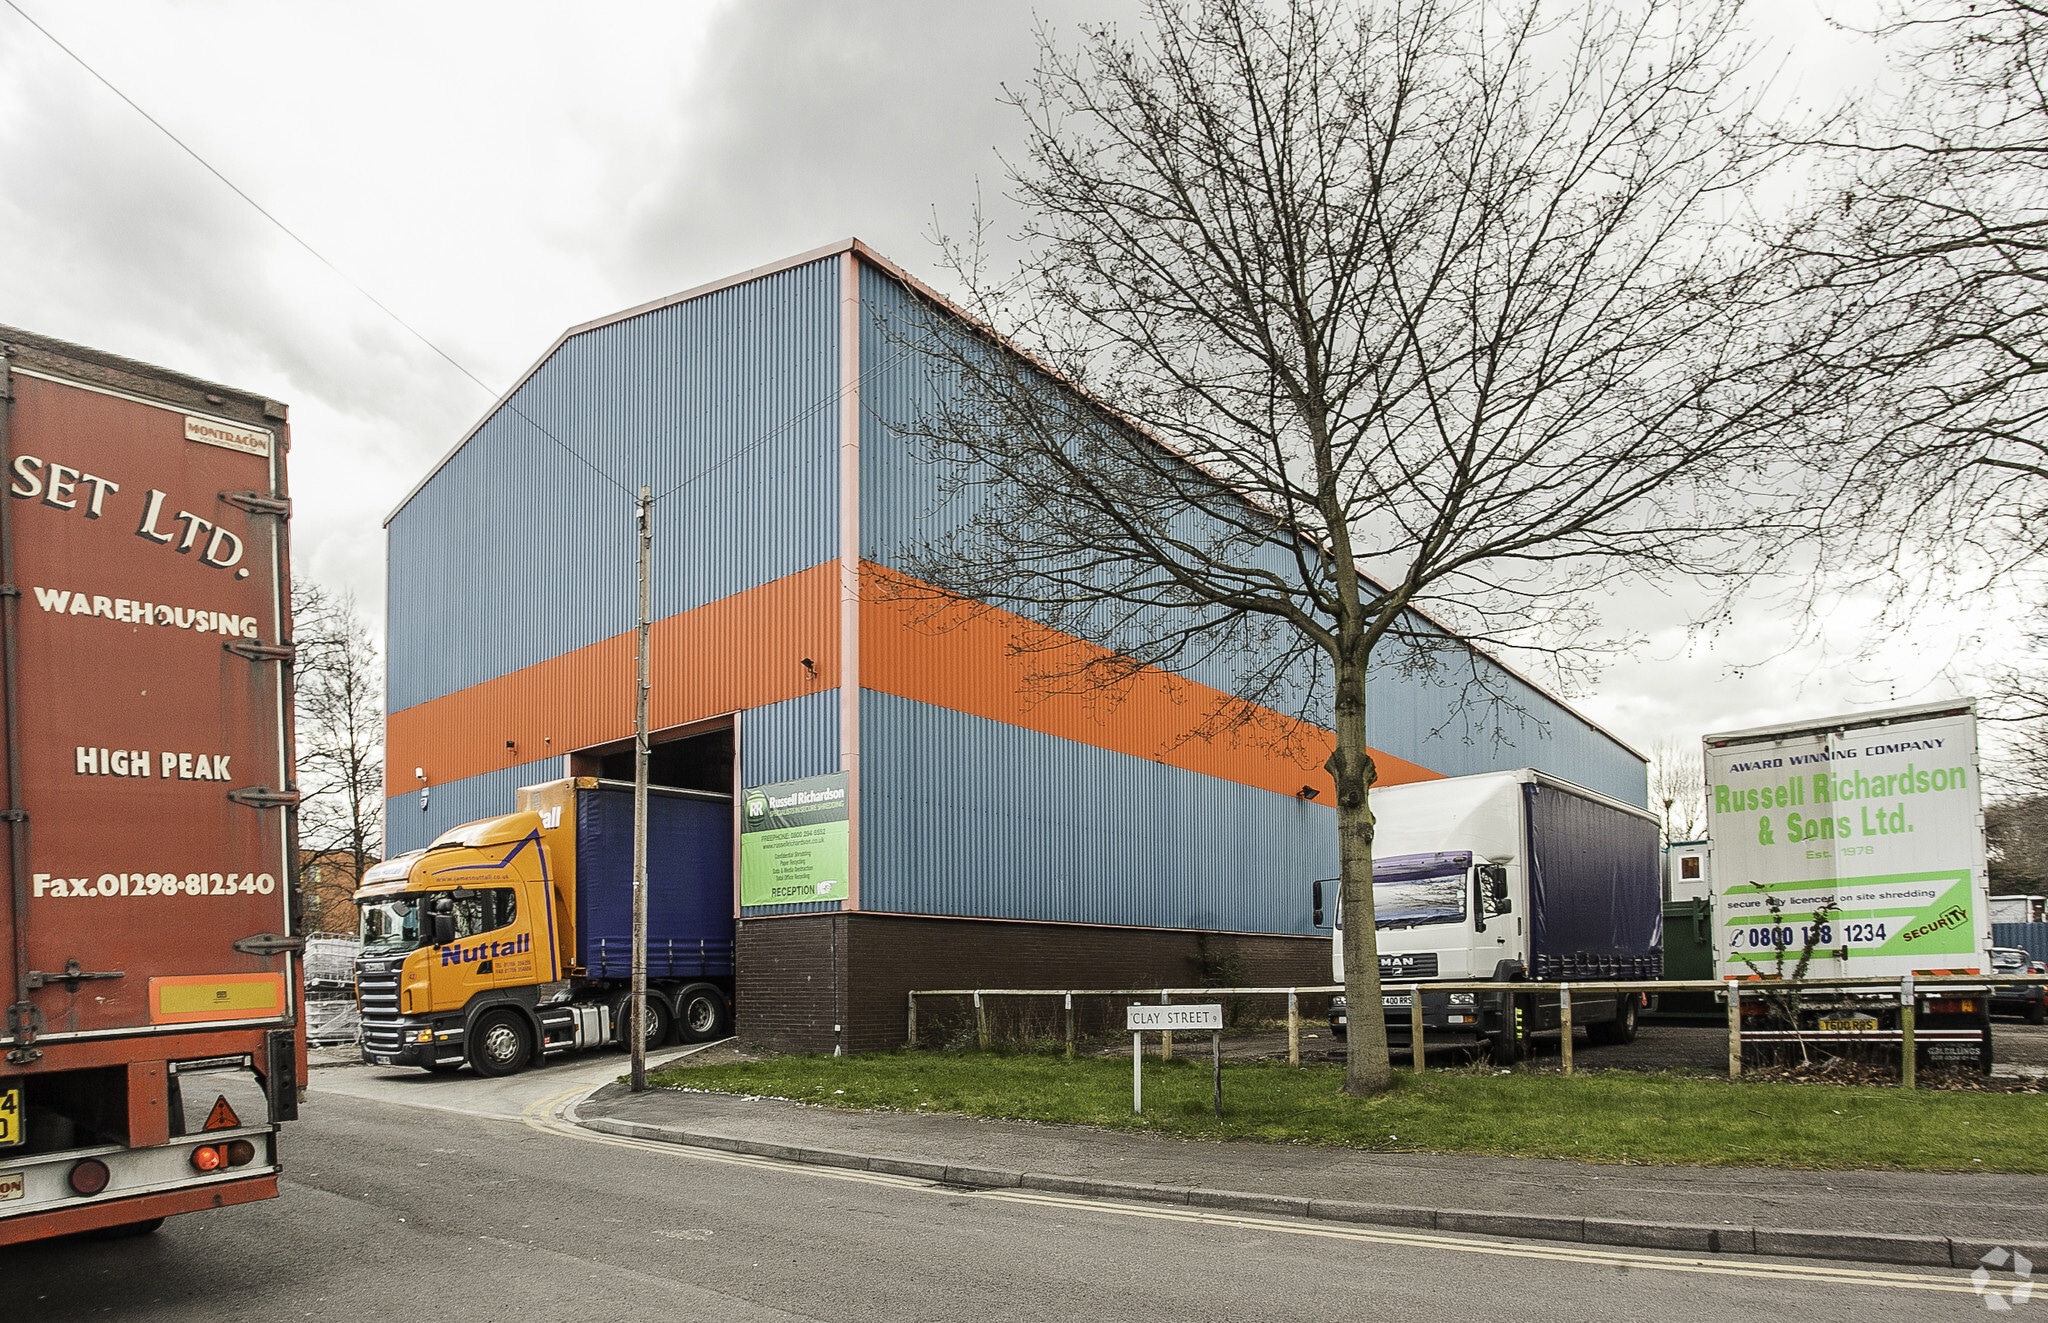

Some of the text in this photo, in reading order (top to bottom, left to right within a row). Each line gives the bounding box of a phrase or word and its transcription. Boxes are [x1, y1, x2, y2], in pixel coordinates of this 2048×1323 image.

[187, 423, 267, 450] MONTRACON
[10, 455, 119, 518] SET
[33, 586, 258, 638] WAREHOUSING
[76, 746, 232, 781] HIGH PEAK
[1729, 738, 1946, 773] AWARD WINNING COMPANY
[769, 787, 845, 810] Russell Richardson
[1715, 763, 1967, 814] Russell Richardson
[749, 801, 764, 817] RR
[1758, 802, 1914, 846] & Sons Ltd.
[1805, 845, 1874, 860] Est. 1978
[771, 884, 815, 898] RECEPTION
[1727, 900, 1761, 909] secure
[1790, 895, 1835, 905] licenced
[1856, 892, 1875, 900] site
[1879, 889, 1936, 901] shredding
[1801, 925, 1832, 946] 18
[1843, 923, 1887, 942] 1234
[441, 932, 530, 967] Nuttall
[1380, 957, 1414, 966] MAN
[1132, 1011, 1217, 1024] CLAY STREET 9
